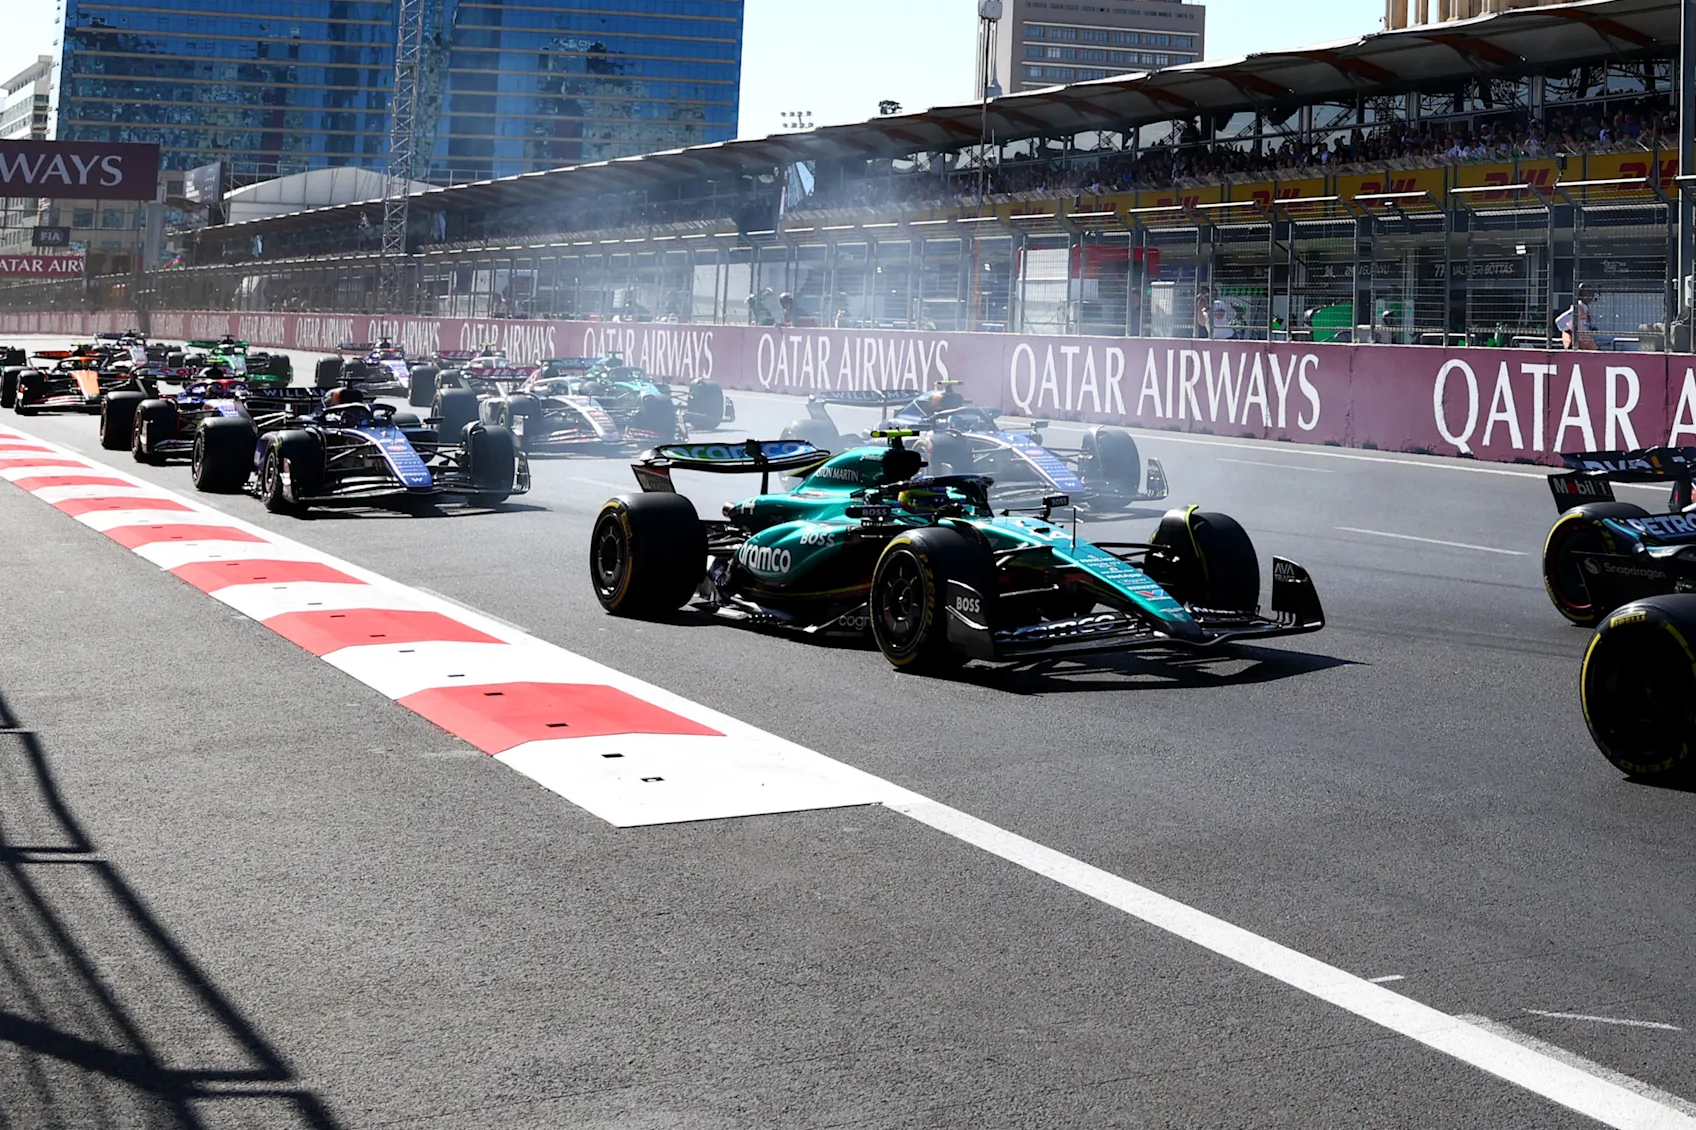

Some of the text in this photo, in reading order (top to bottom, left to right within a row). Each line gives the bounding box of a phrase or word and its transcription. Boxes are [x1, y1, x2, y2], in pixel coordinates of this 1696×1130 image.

[1360, 179, 1417, 206] DHL
[1482, 169, 1555, 199] DHL
[40, 231, 61, 242] FIA
[502, 326, 556, 365] AIRWAYS
[638, 330, 714, 379] AIRWAYS
[757, 333, 949, 392] QATAR AIRWAYS
[1010, 343, 1320, 432] QATAR AIRWAYS
[1434, 358, 1640, 456] QATAR
[833, 467, 859, 482] MARTIN
[1553, 477, 1596, 495] Mobil
[1051, 497, 1068, 506] BOSS
[862, 508, 888, 517] BOSS
[800, 530, 836, 548] BOSS
[738, 541, 792, 573] aramco
[1274, 562, 1295, 576] AVA
[1604, 562, 1666, 580] Snapdragon
[956, 595, 981, 613] BOSS
